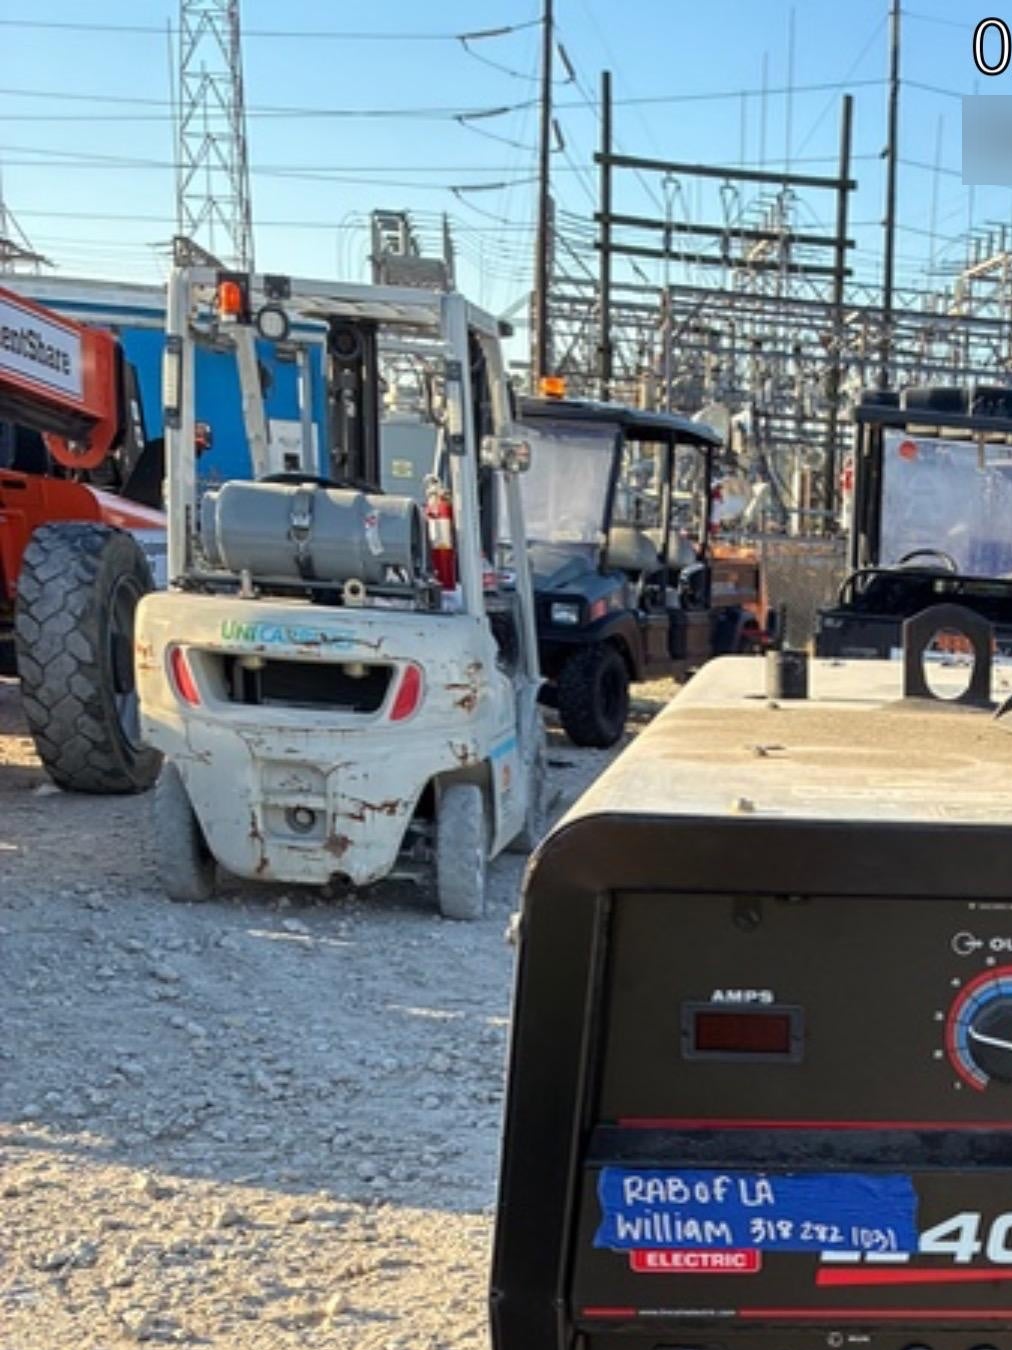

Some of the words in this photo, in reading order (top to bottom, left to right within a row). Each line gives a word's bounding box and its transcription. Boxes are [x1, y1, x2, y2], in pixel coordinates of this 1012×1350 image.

[710, 989, 775, 1005] AMPS
[740, 1178, 776, 1206] LA
[750, 1217, 792, 1244] 318
[647, 1253, 747, 1268] ELECTRIC
